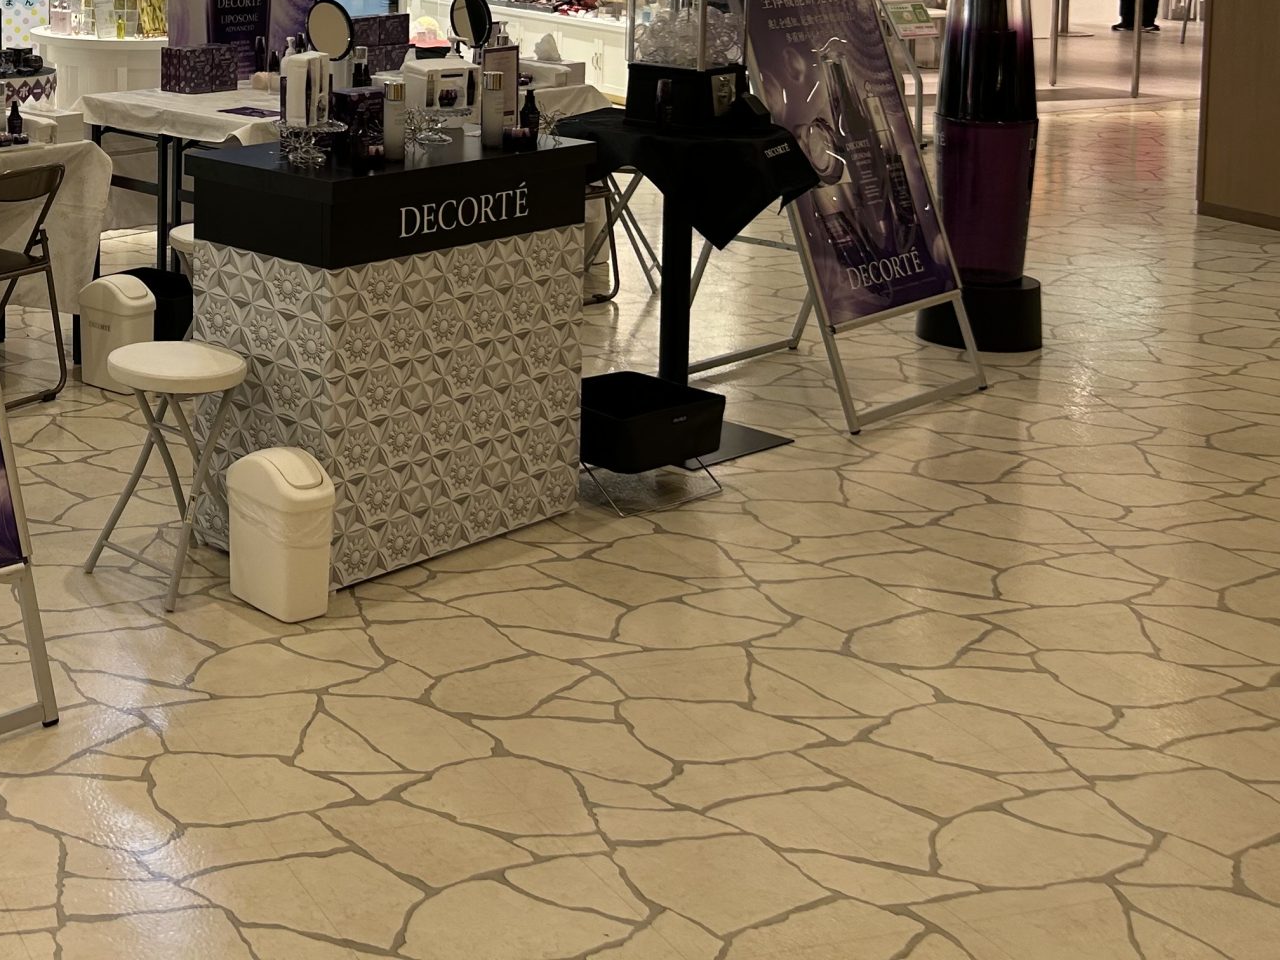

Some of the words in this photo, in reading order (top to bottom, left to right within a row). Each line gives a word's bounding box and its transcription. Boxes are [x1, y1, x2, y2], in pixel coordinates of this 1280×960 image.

[221, 13, 259, 24] LIPOSOME
[399, 182, 529, 238] DECORTÉ
[846, 246, 924, 290] DECORTÉ
